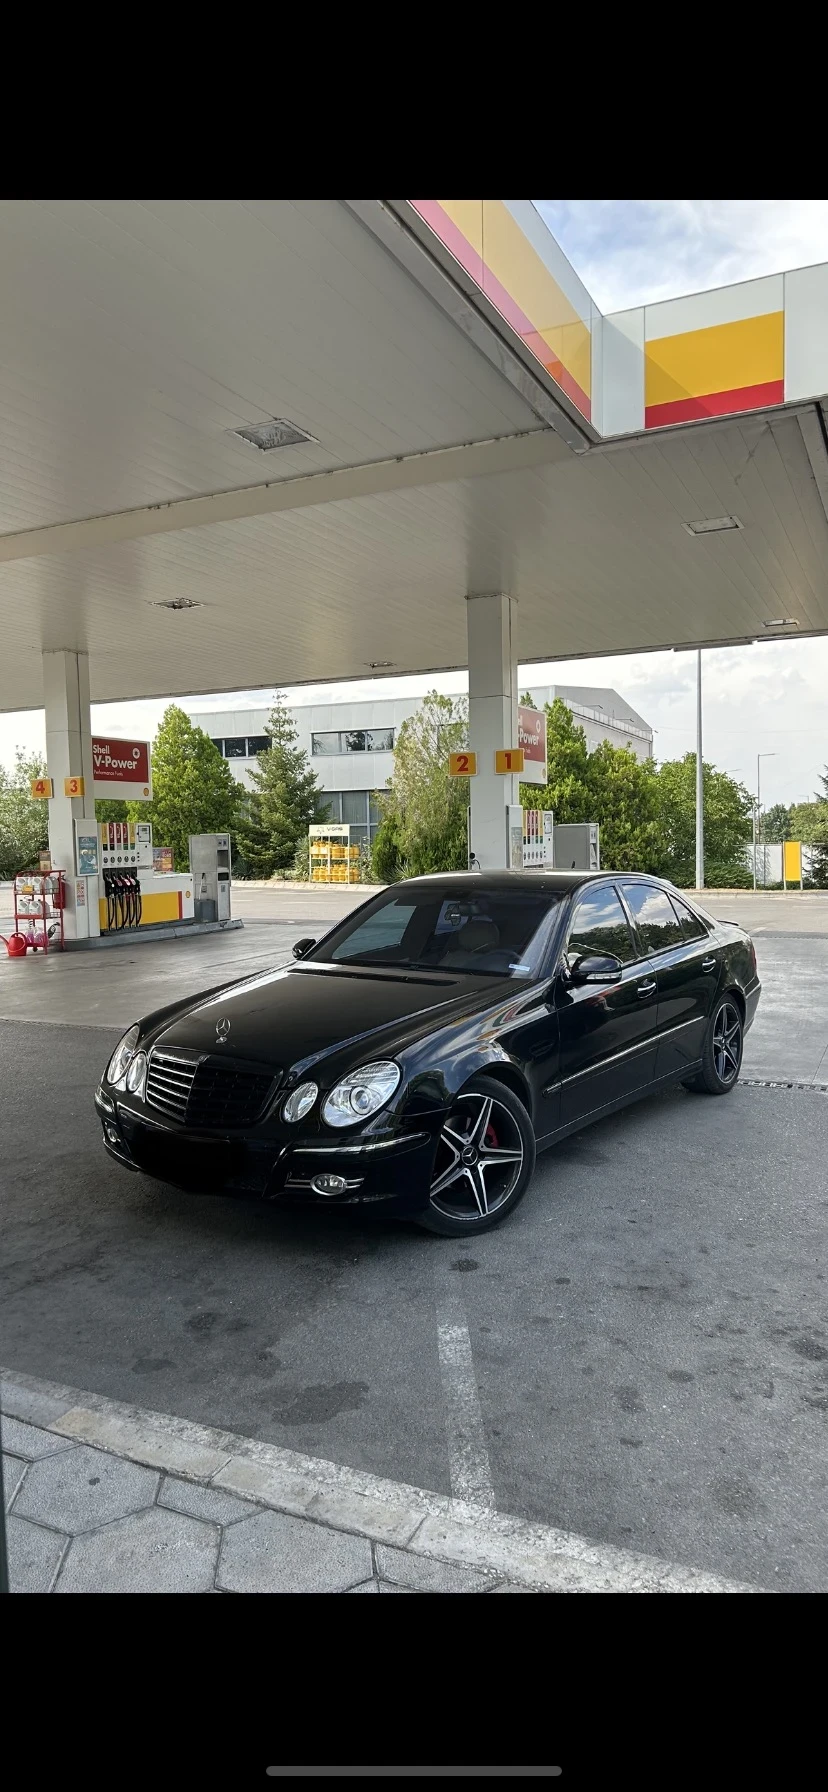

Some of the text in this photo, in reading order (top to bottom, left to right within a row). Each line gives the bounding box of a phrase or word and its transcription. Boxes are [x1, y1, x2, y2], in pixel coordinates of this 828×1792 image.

[93, 744, 110, 754] Shell
[94, 755, 138, 770] V-Power
[457, 755, 469, 772] 2
[505, 753, 512, 770] 1
[36, 781, 46, 794] 4
[70, 779, 78, 793] 3
